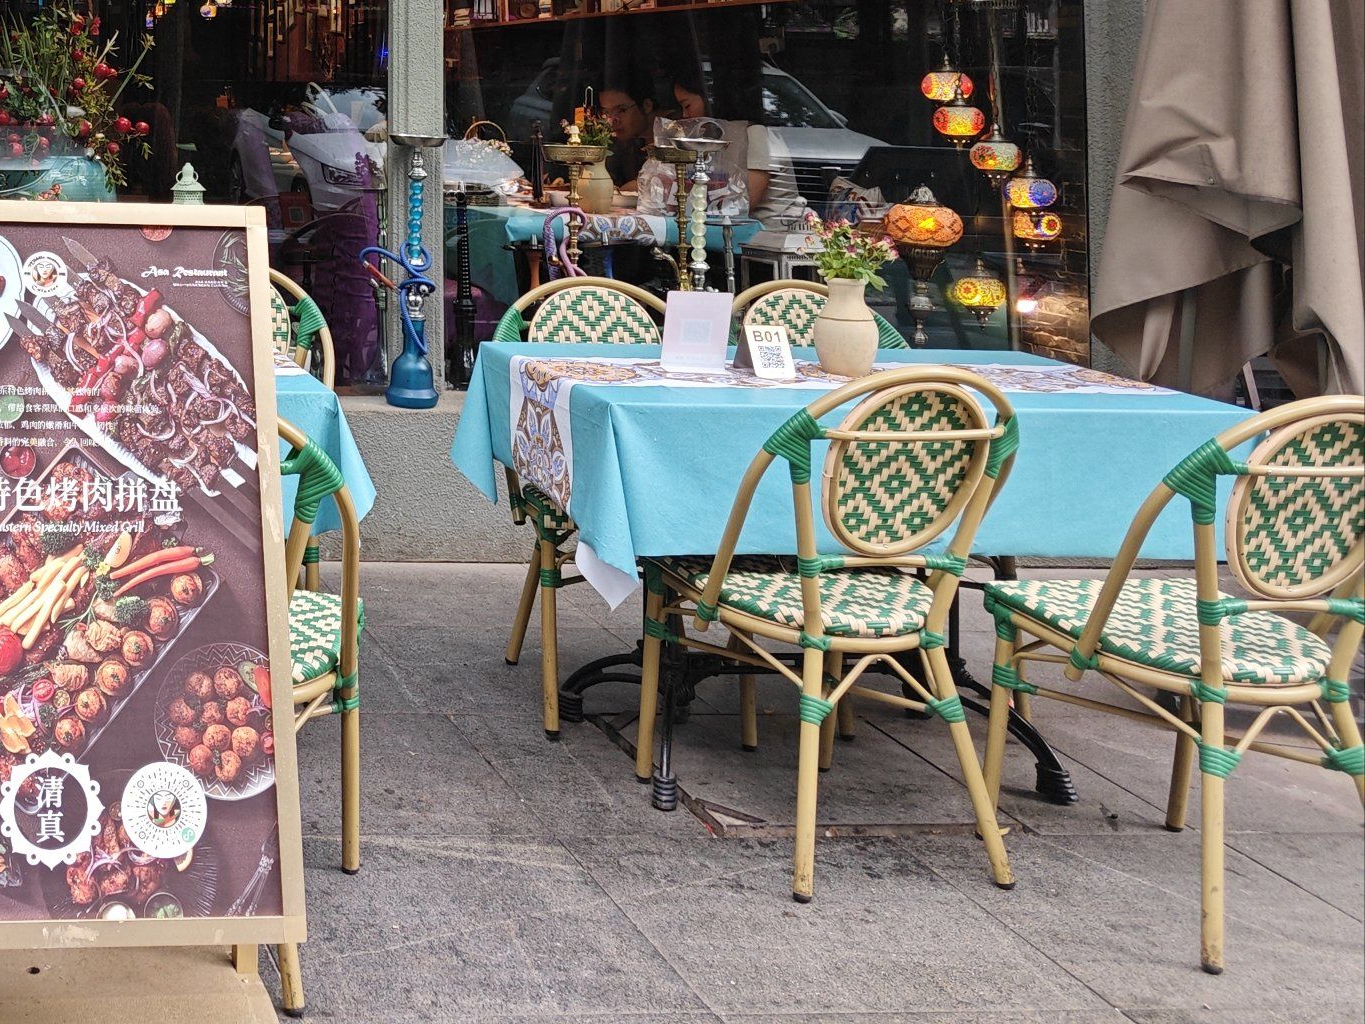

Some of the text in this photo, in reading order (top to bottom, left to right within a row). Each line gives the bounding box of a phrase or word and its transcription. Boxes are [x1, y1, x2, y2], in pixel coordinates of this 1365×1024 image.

[753, 330, 782, 343] B01
[121, 520, 145, 532] Grill
[36, 776, 65, 843] 清真
